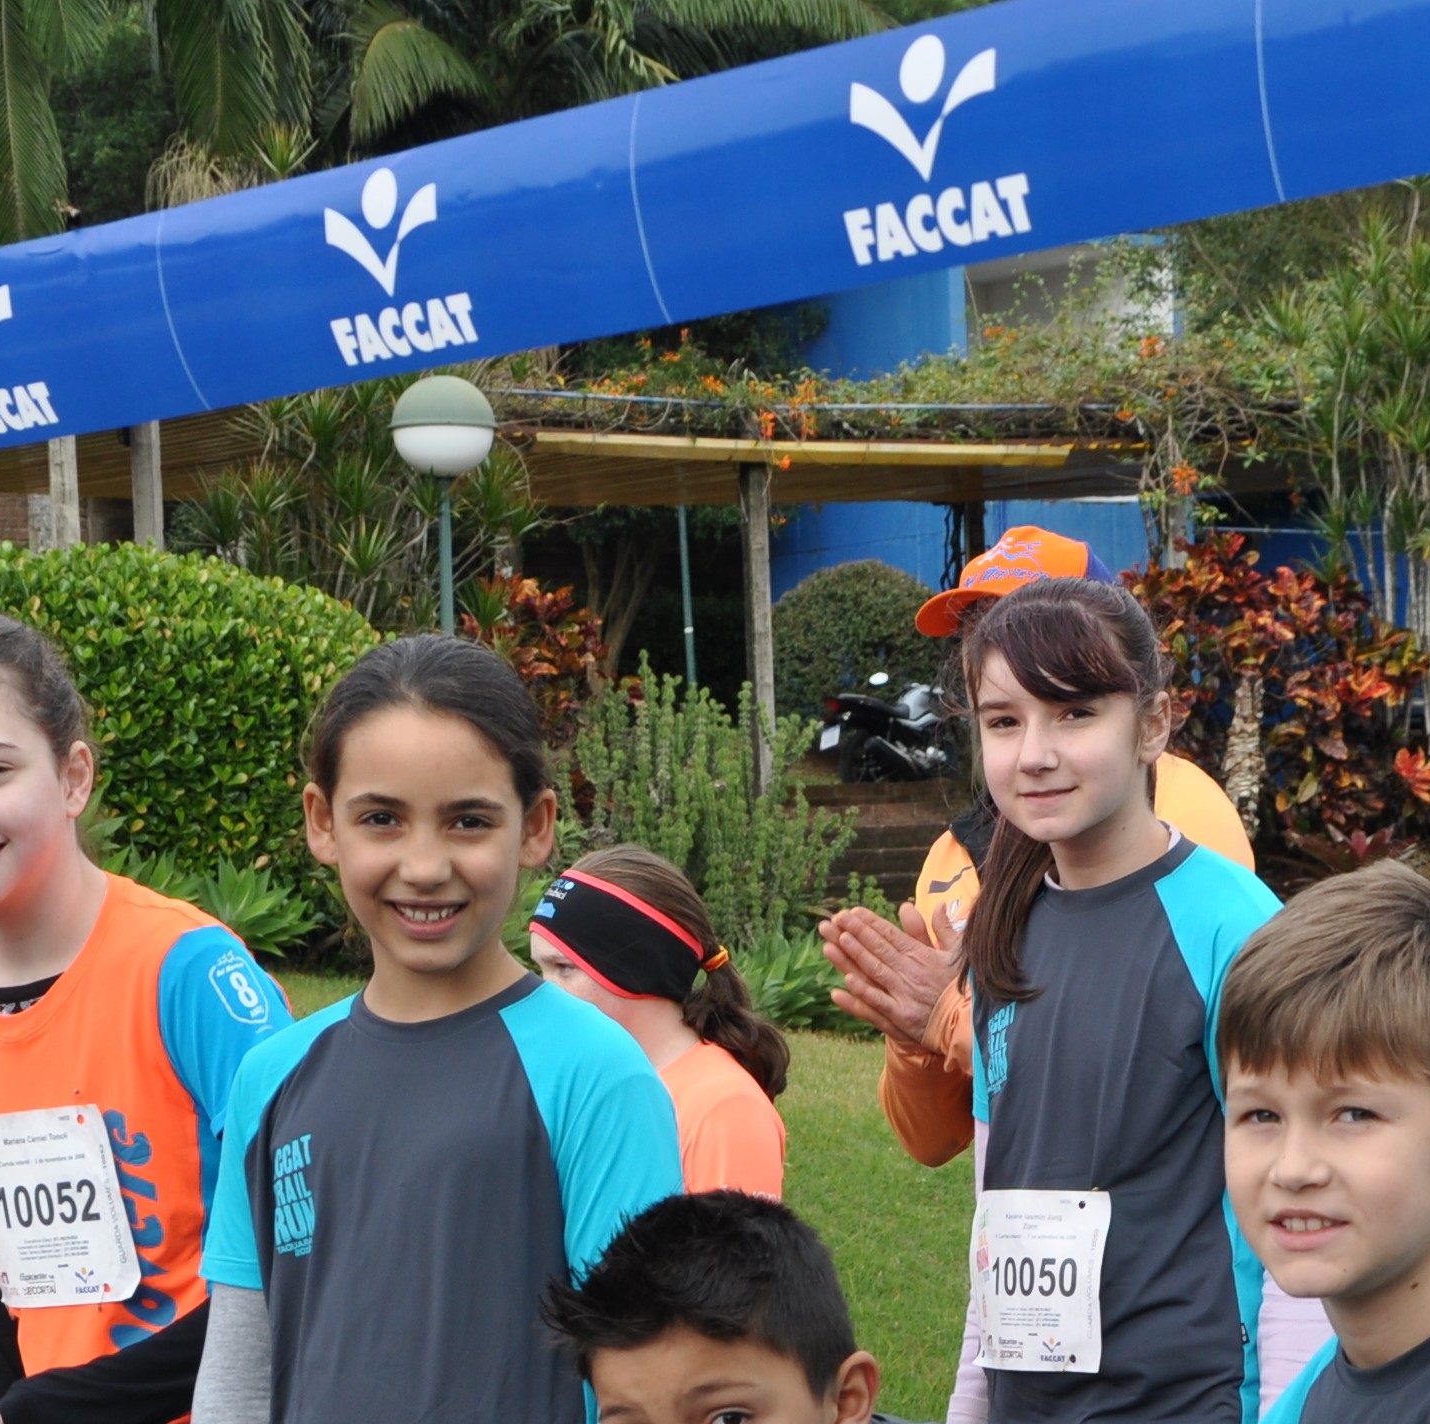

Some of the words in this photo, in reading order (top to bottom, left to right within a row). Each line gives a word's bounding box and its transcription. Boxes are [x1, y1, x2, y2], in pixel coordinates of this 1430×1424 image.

[843, 172, 1031, 266] FACCAT
[330, 291, 479, 367] FACCAT
[229, 971, 259, 1008] 8
[274, 1197, 316, 1245] RUN
[75, 1285, 100, 1294] FACCAT
[992, 1257, 1078, 1297] 10050
